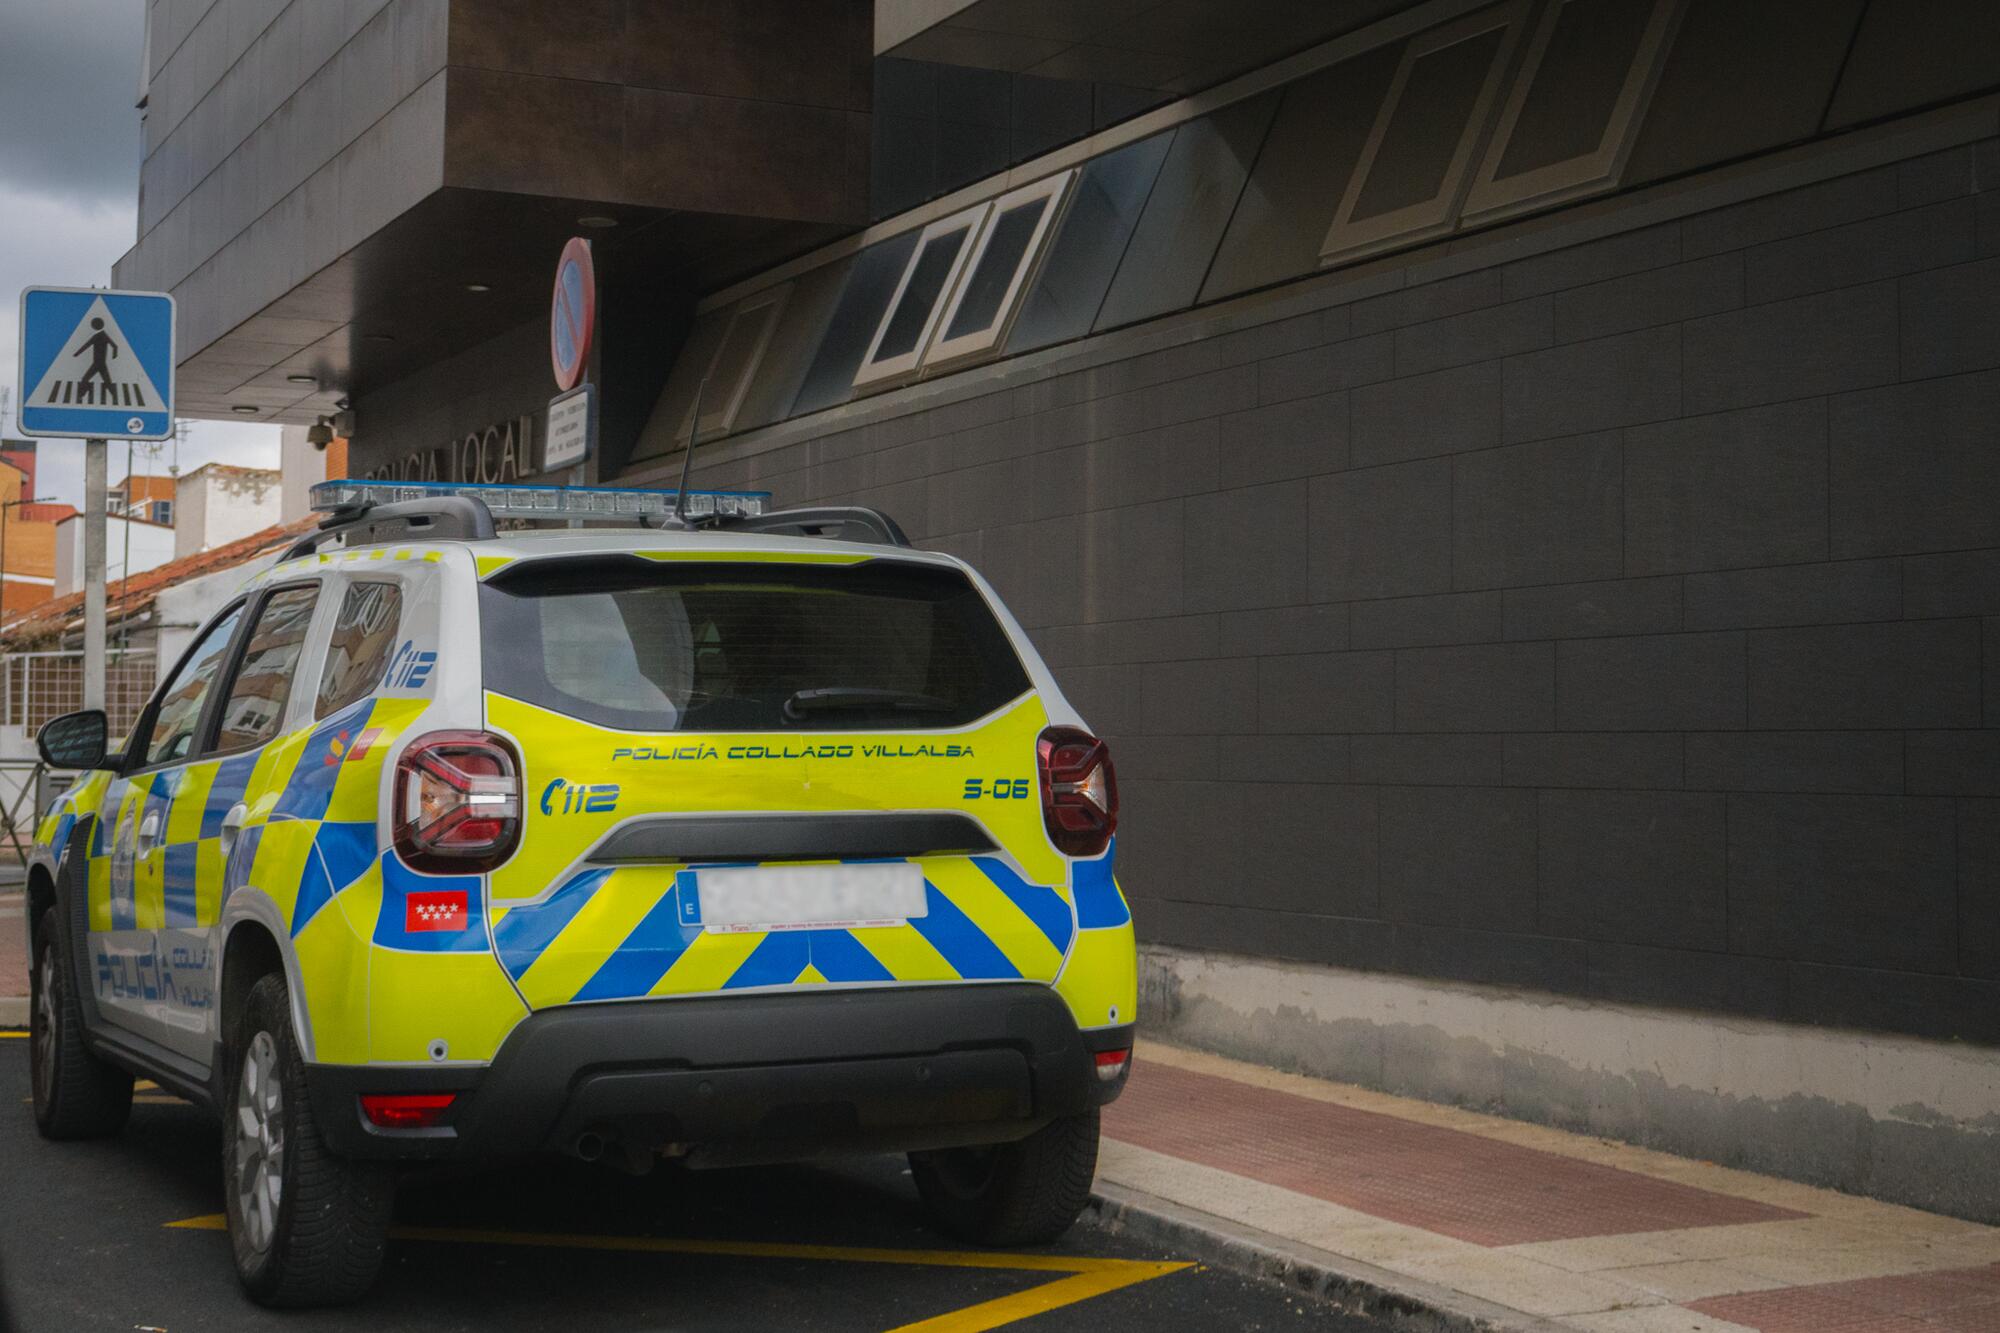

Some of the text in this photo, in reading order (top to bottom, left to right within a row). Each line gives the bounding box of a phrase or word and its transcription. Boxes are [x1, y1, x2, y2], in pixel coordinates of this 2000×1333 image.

[452, 415, 536, 484] LOCAL
[393, 650, 438, 689] 112
[612, 742, 974, 761] POLICÍA COLLADO VILLALBA
[562, 784, 620, 815] 112
[963, 779, 1029, 799] S-06
[685, 903, 695, 915] E
